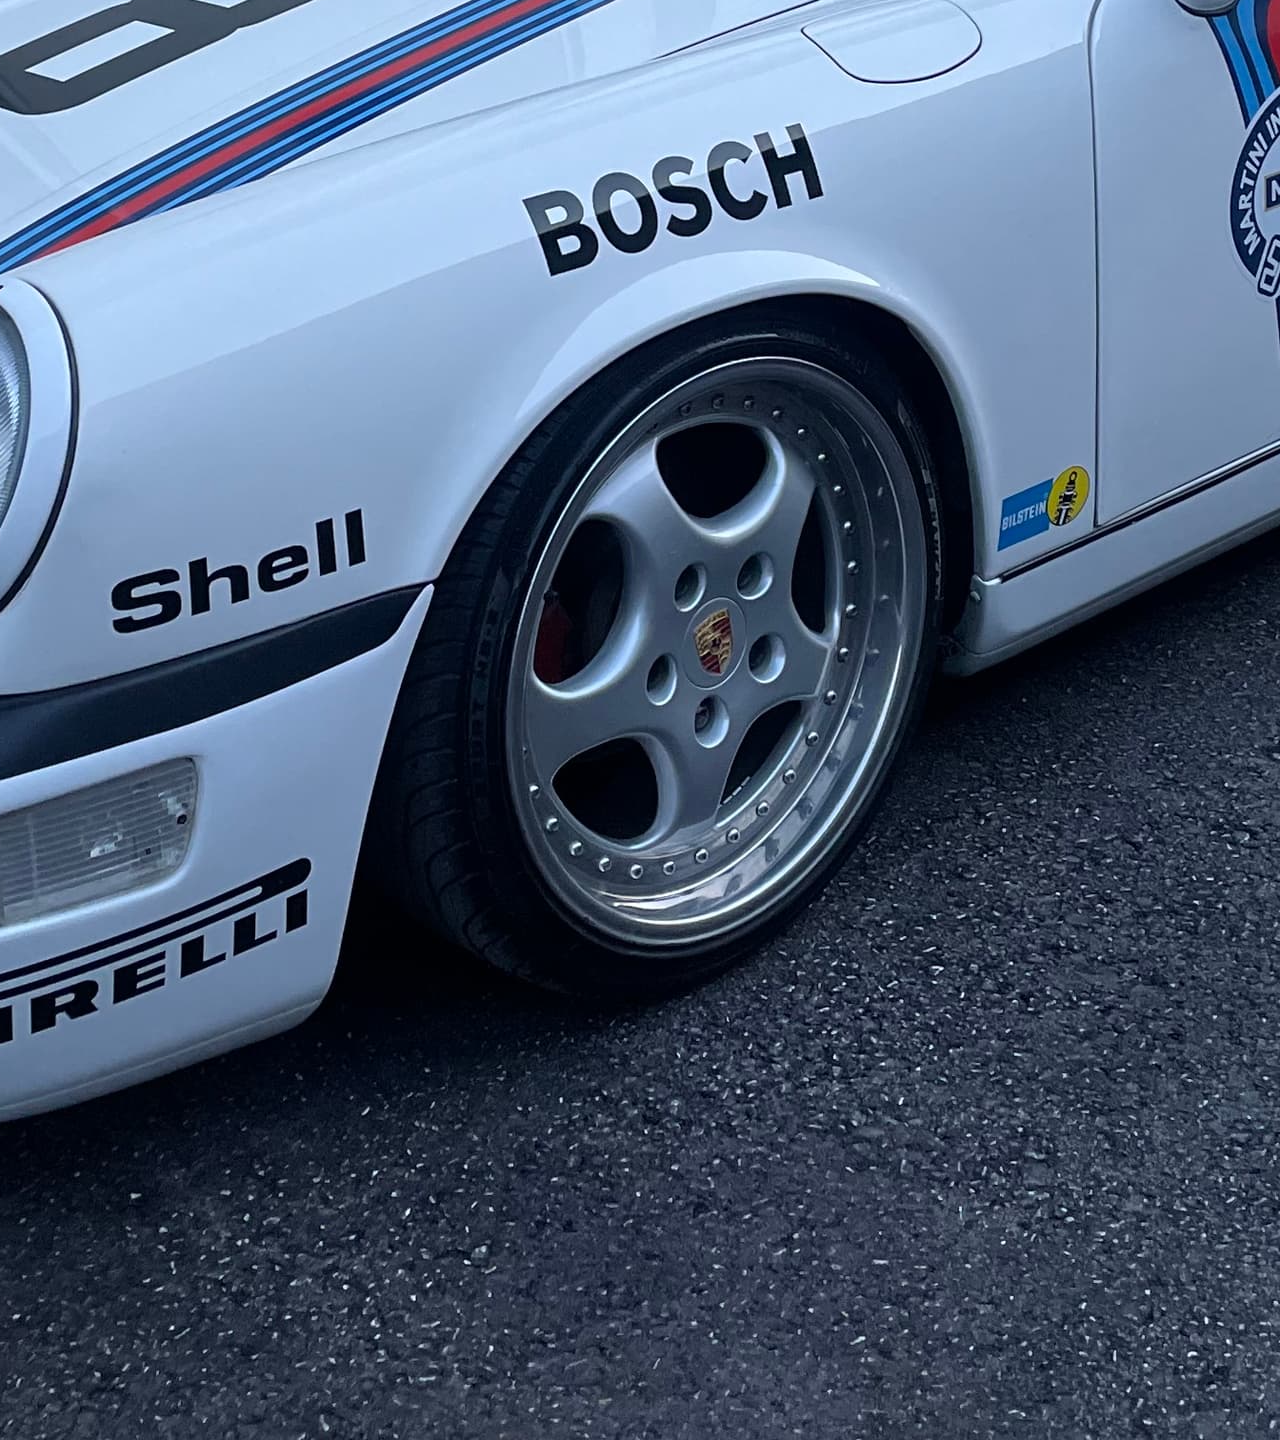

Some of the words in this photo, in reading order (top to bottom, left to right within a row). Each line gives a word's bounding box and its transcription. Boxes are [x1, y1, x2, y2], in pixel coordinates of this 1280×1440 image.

[522, 123, 824, 277] BOSCH
[1238, 133, 1268, 256] MARTINI
[111, 508, 366, 634] Shell
[1002, 500, 1047, 532] BILSTEIN
